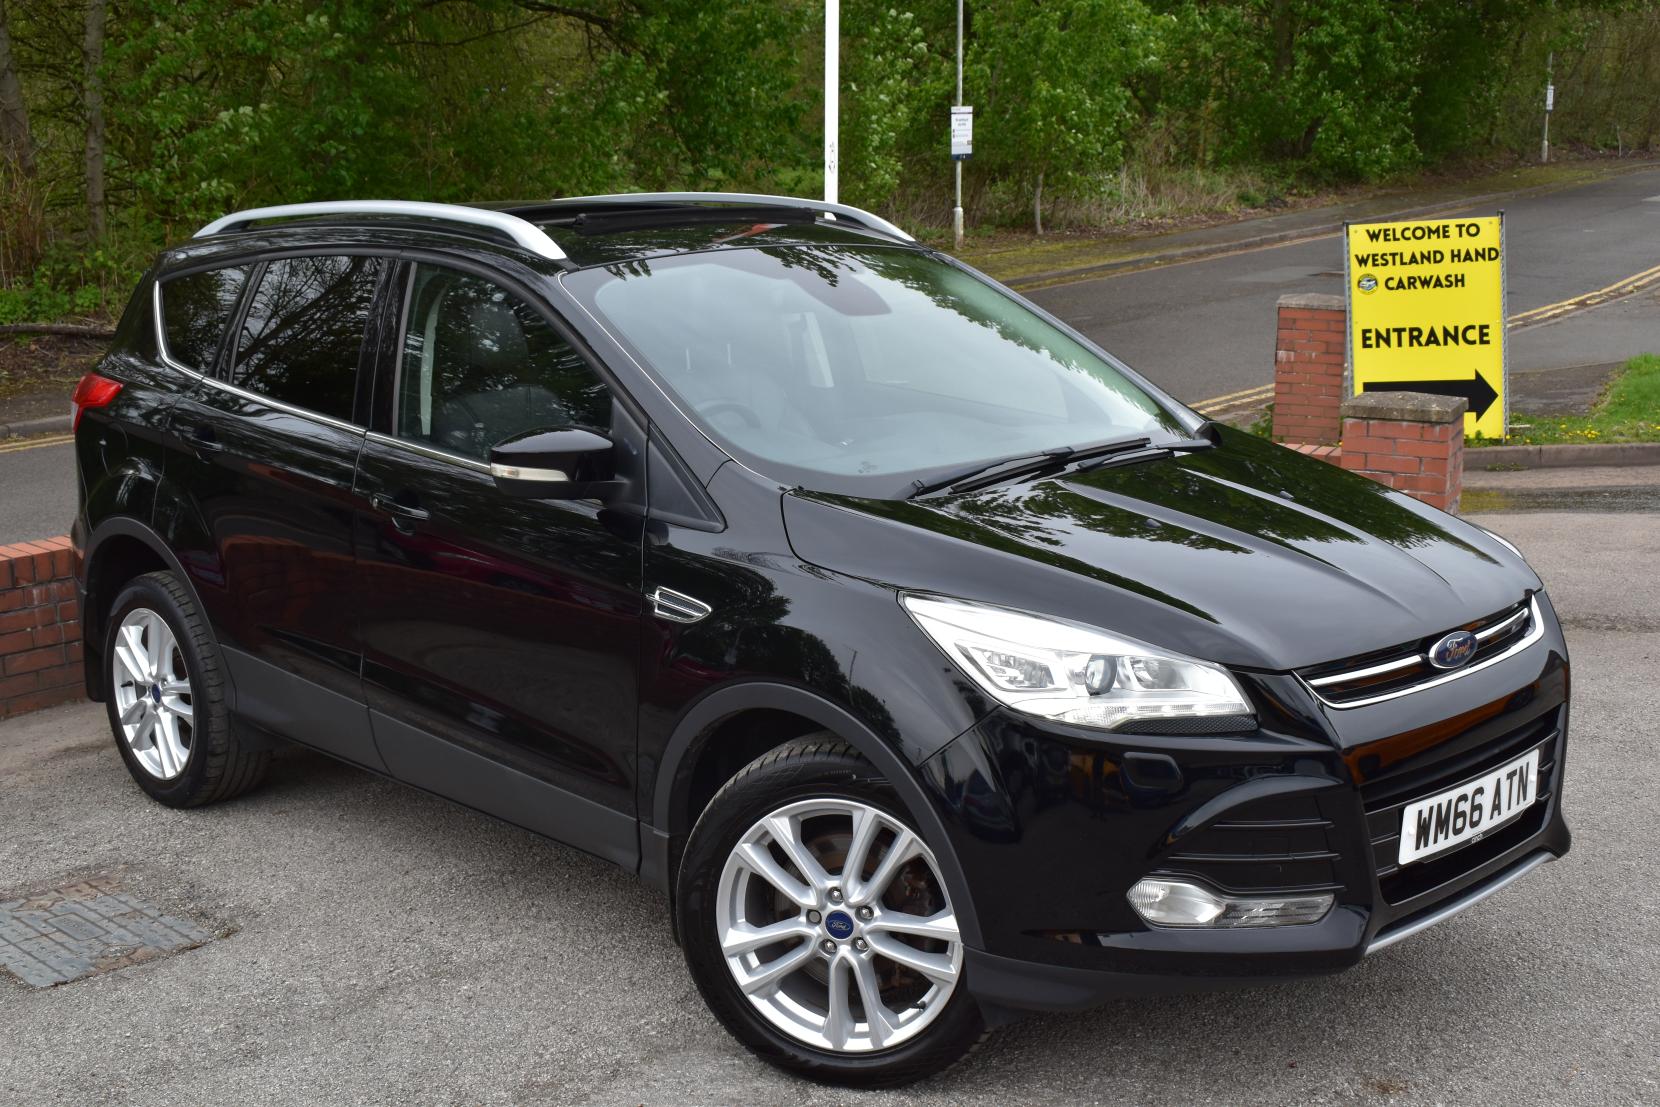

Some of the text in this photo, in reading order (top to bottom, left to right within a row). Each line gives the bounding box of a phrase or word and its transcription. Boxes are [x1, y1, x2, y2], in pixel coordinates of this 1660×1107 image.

[1366, 223, 1480, 242] WELCOME TO
[1355, 247, 1499, 267] WESTLAND HAND
[1384, 274, 1465, 290] CARWASH
[1361, 325, 1490, 348] ENTRANCE
[1446, 637, 1471, 662] Ford
[1415, 762, 1530, 851] WM66 ATN
